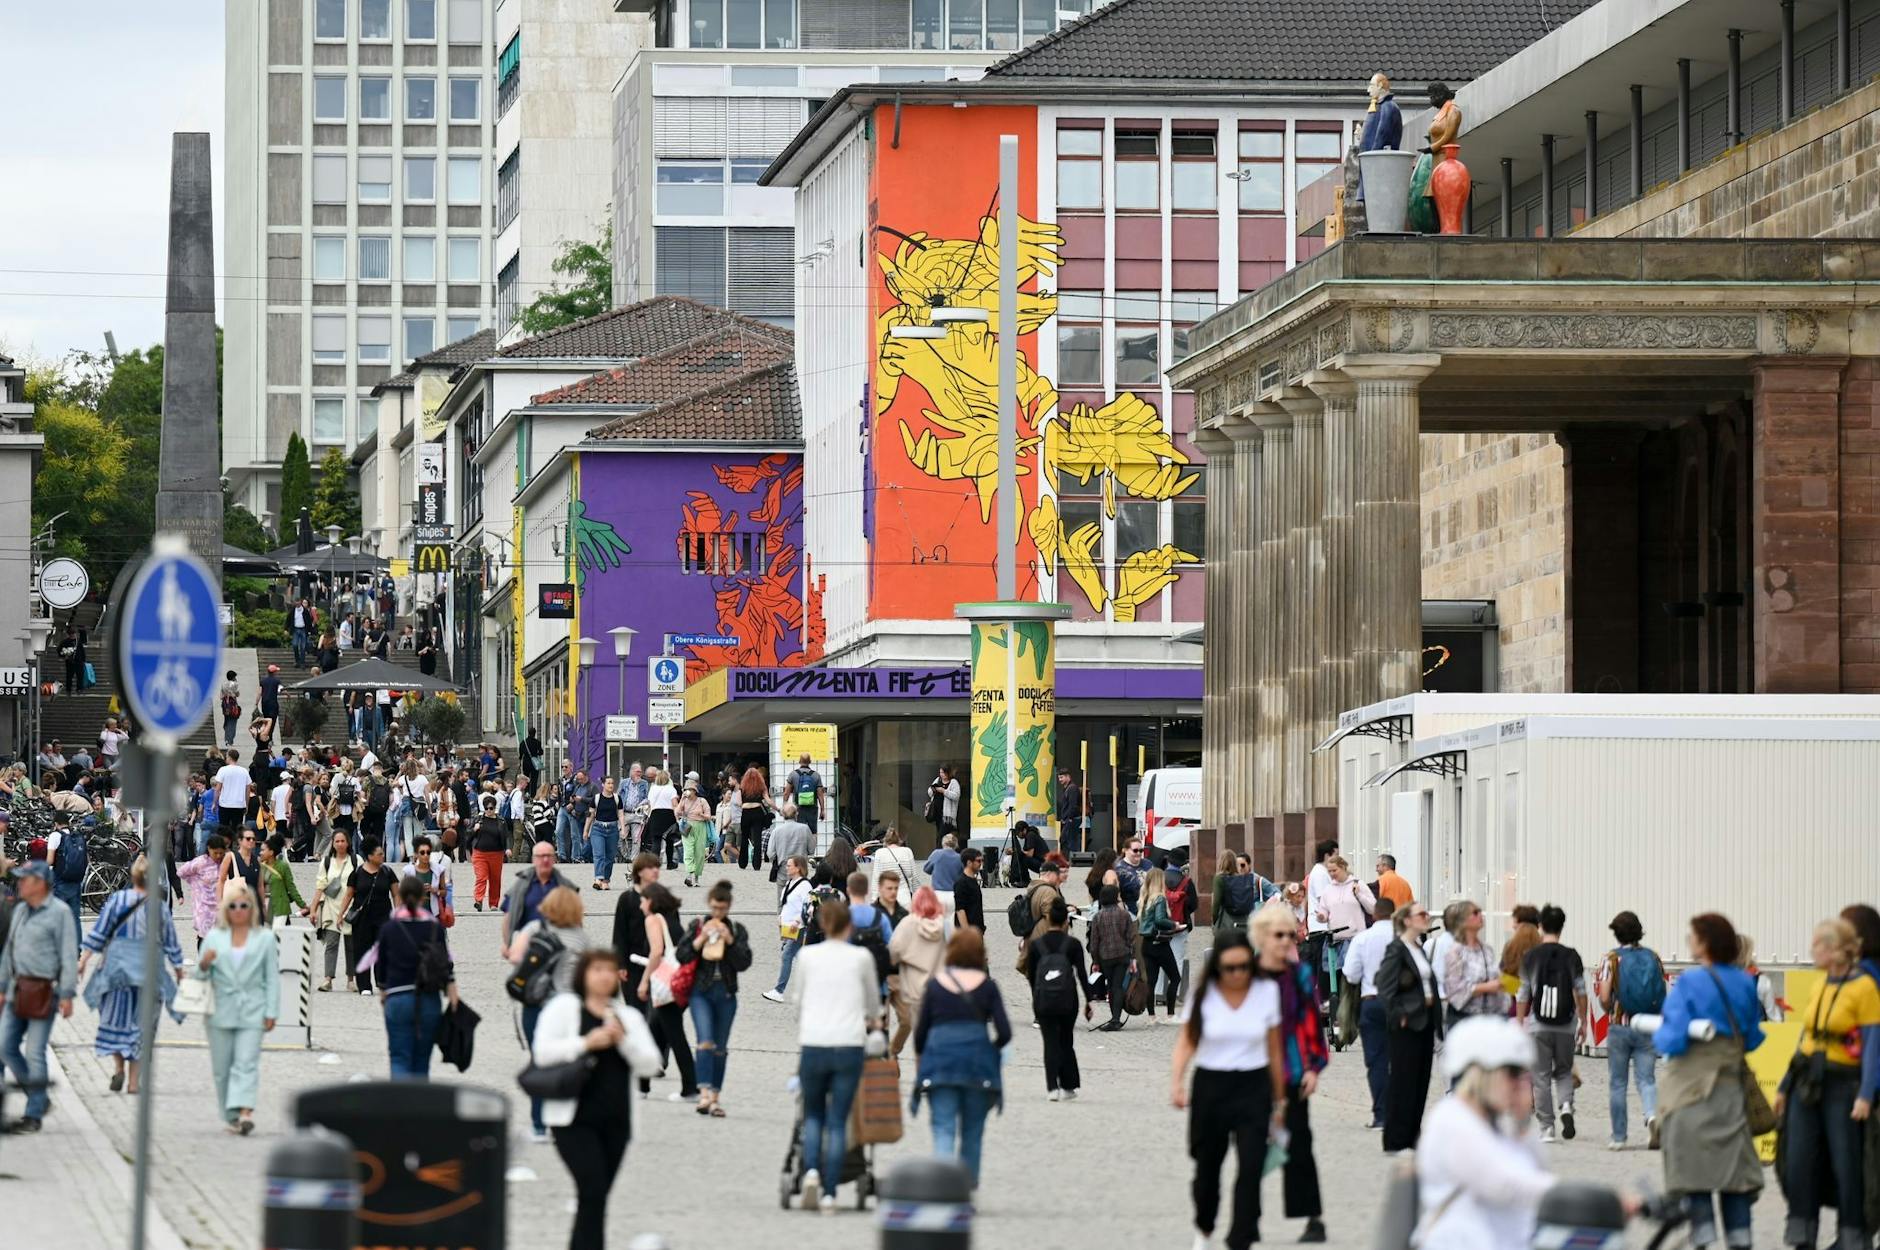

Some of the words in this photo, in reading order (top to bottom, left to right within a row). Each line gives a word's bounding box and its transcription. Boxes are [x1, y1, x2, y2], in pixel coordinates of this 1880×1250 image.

[424, 491, 436, 523] snipes
[417, 527, 445, 539] snipes
[695, 636, 737, 645] Königsstraße
[21, 687, 26, 695] 4
